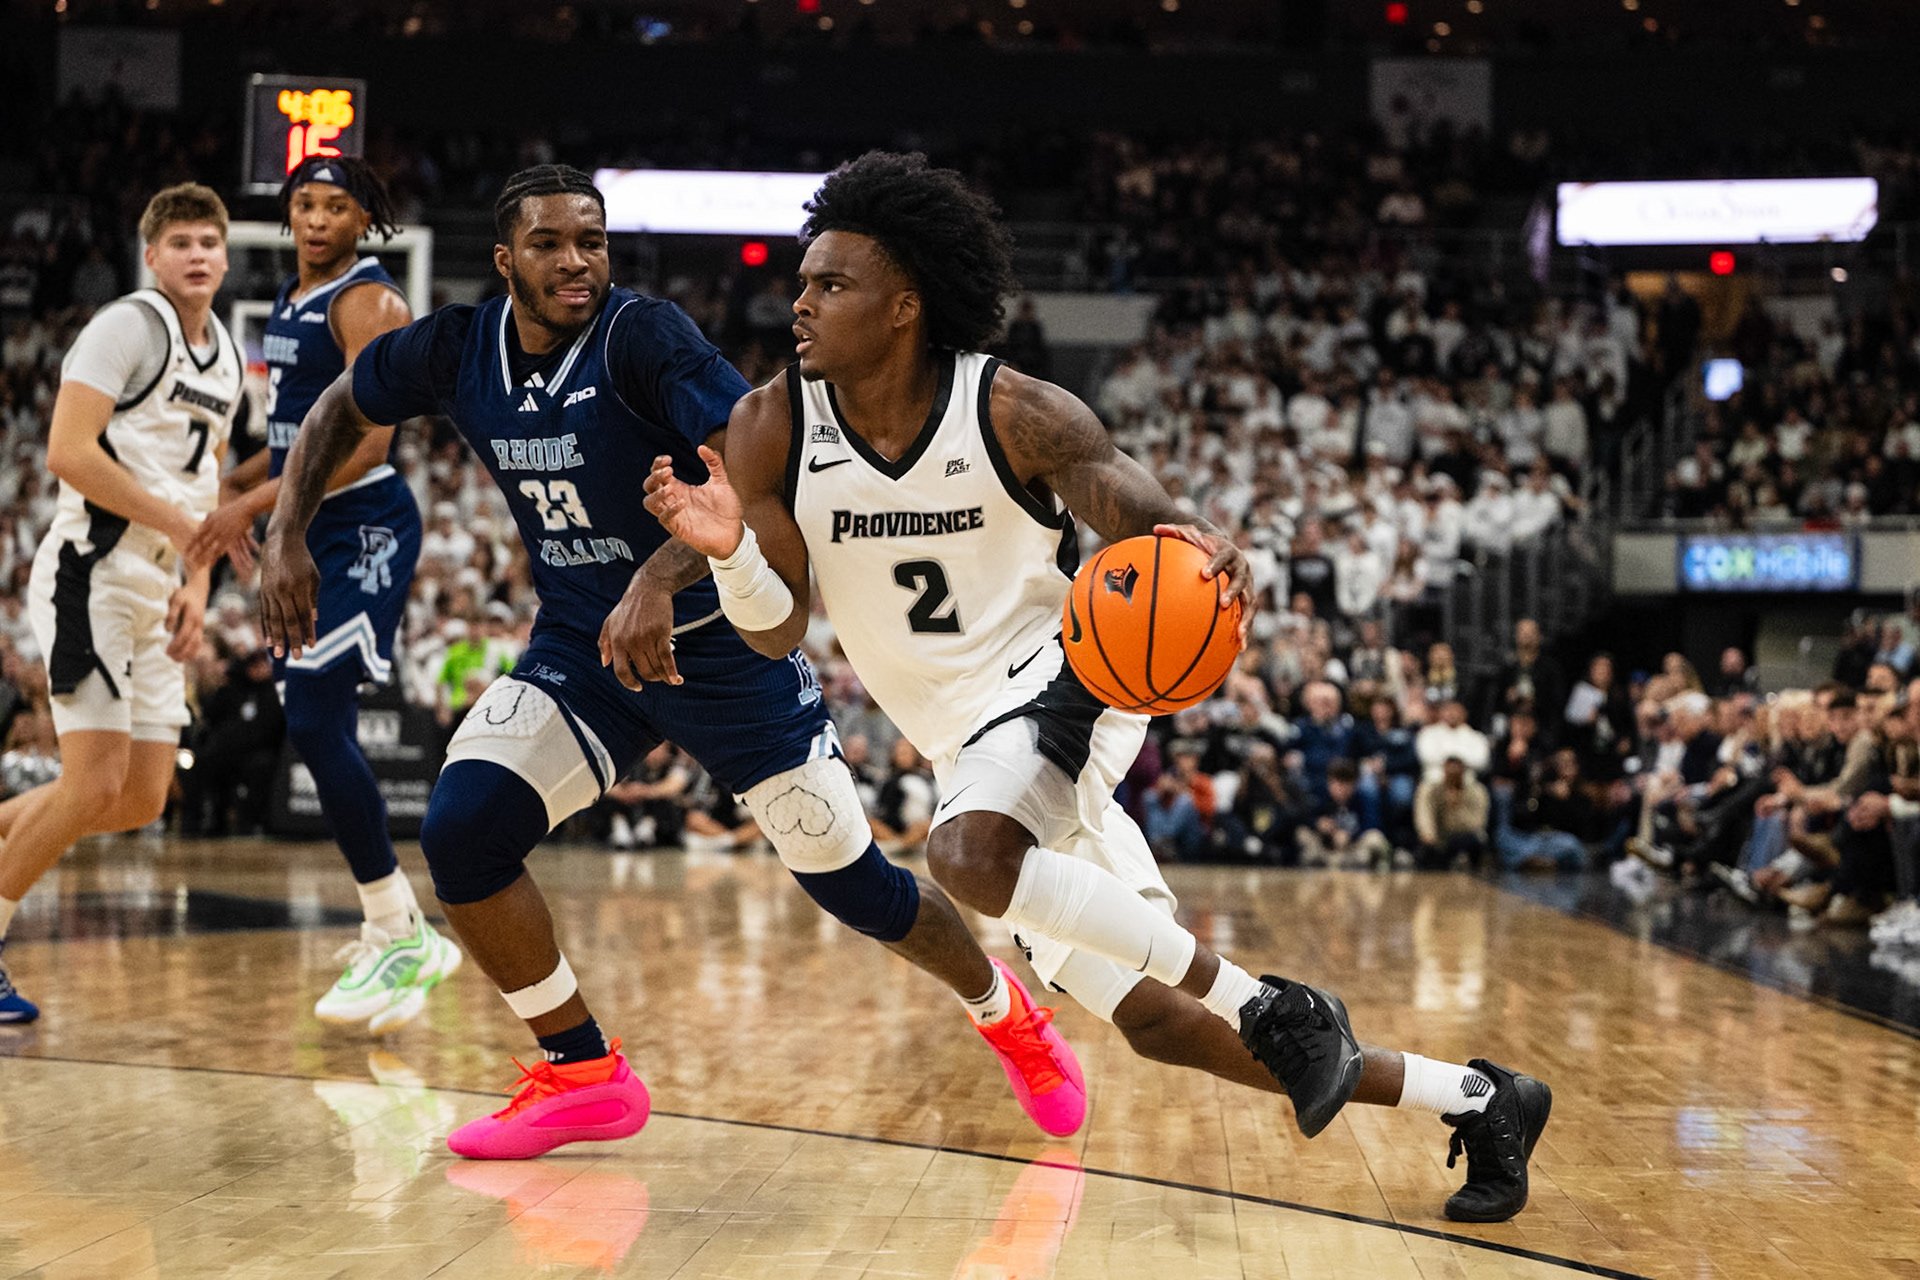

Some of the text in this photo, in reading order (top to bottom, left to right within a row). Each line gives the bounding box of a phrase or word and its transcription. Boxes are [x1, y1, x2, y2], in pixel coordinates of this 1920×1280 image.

[182, 420, 209, 474] 7
[811, 434, 840, 444] CHANGE
[812, 425, 839, 435] BE THE
[490, 433, 585, 471] RHODE
[945, 464, 971, 475] EAST
[947, 458, 964, 467] BIG
[519, 480, 593, 531] 23
[831, 505, 985, 544] PROVIDENCE
[891, 557, 966, 635] 2
